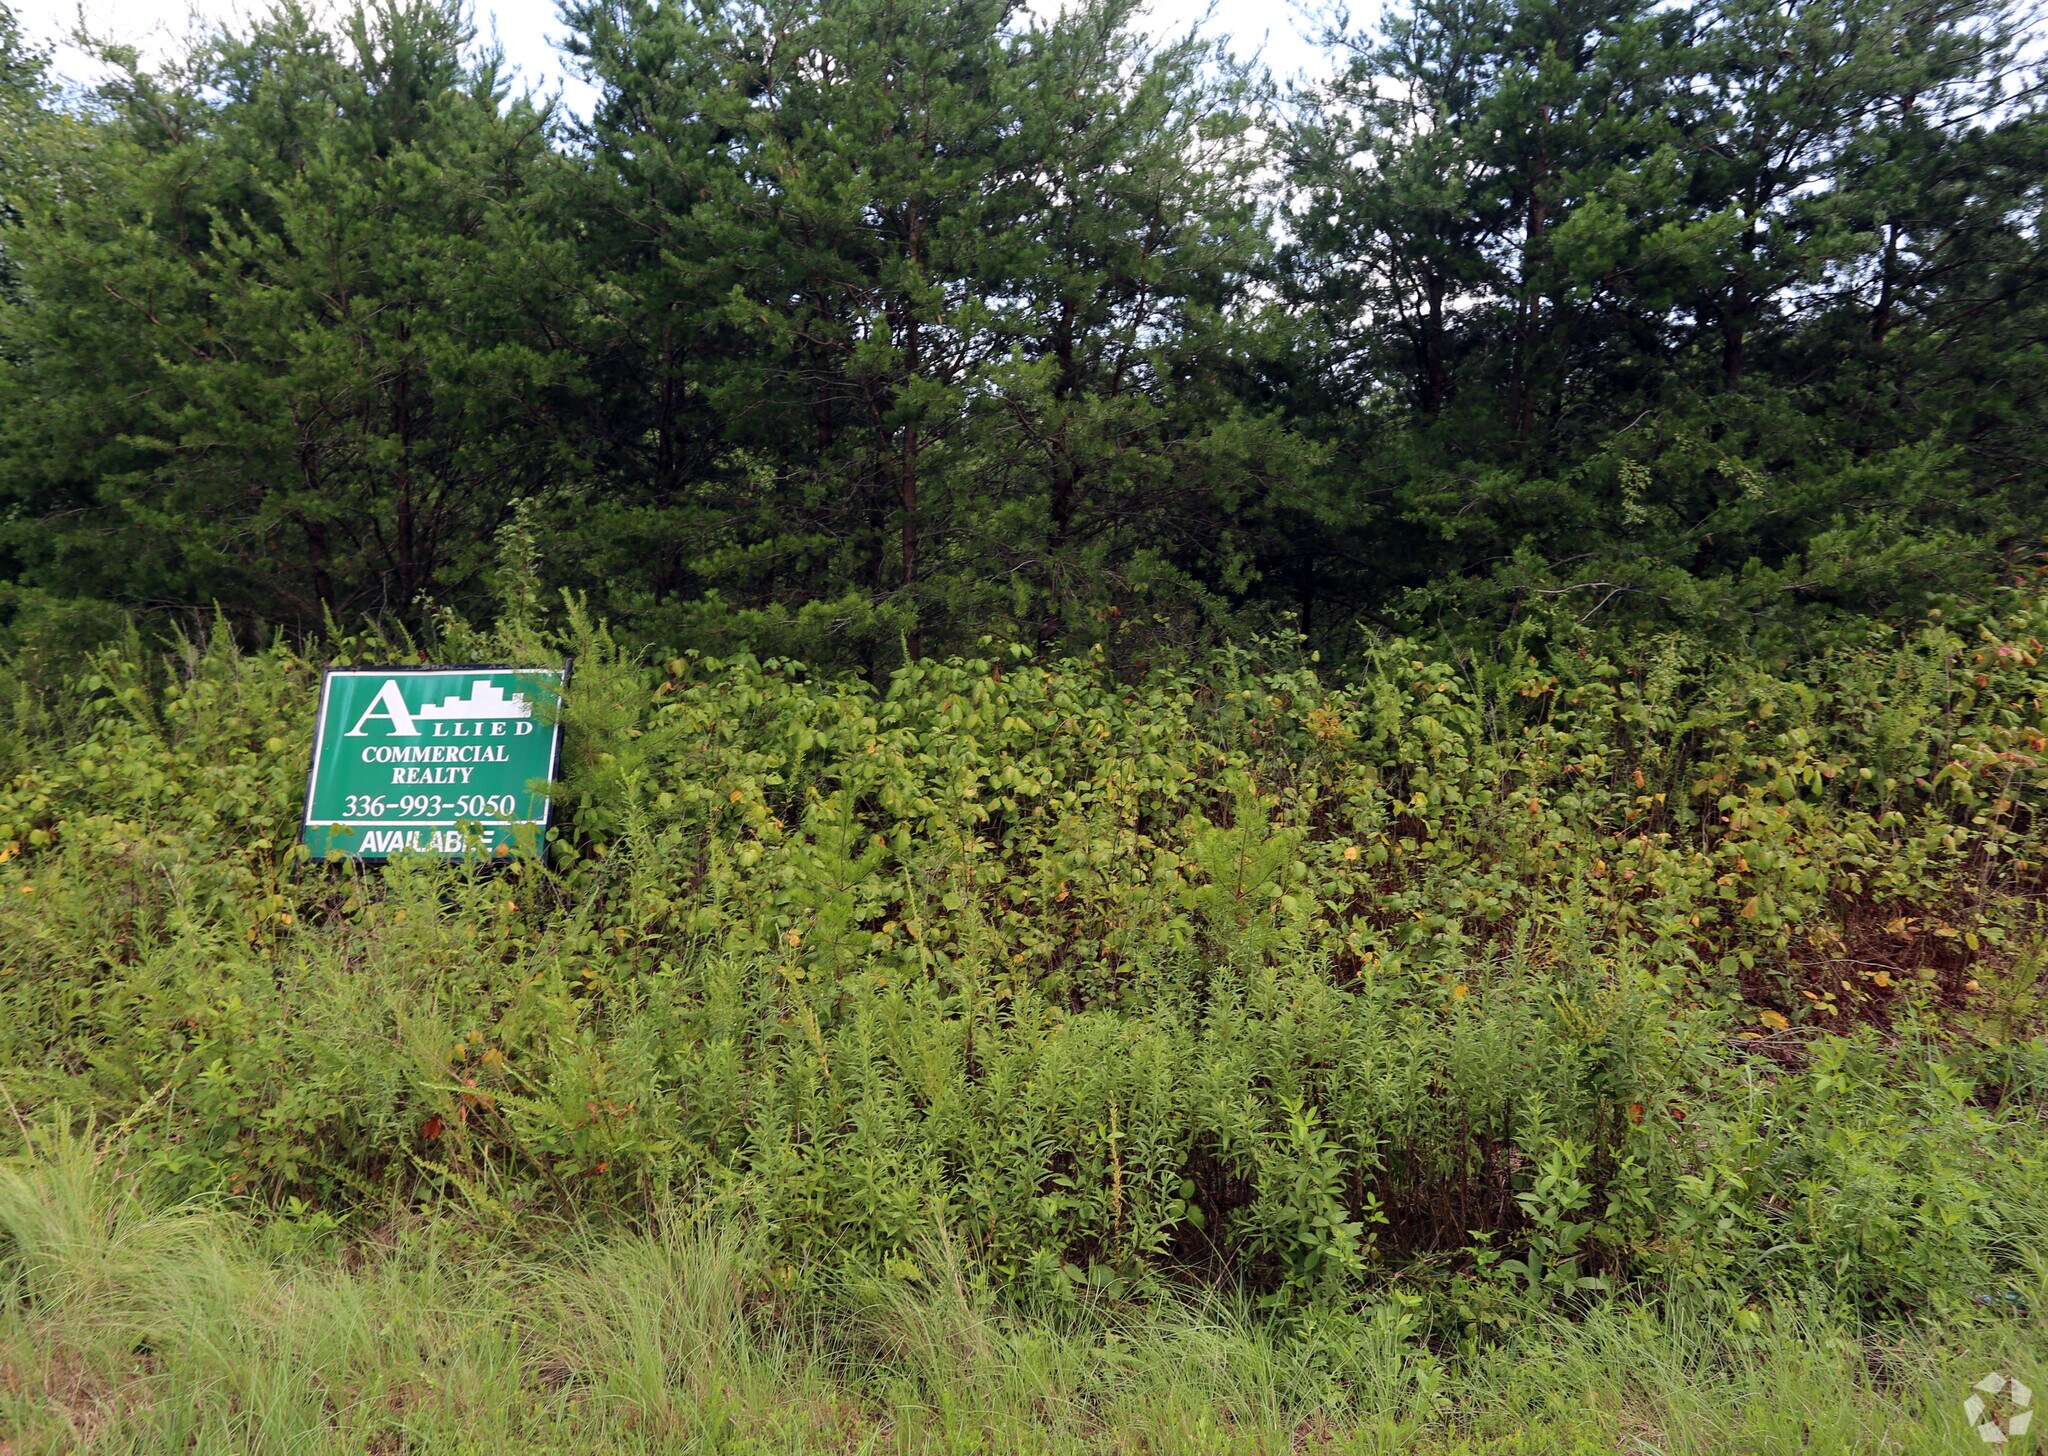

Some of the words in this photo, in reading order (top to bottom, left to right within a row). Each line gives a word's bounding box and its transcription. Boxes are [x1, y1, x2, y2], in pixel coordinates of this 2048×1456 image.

[344, 679, 533, 737] ALLIED
[361, 745, 510, 763] COMMERCIAL
[390, 767, 474, 784] REALTY
[342, 794, 516, 818] 336-993-5050
[358, 830, 495, 853] AVAILABE
